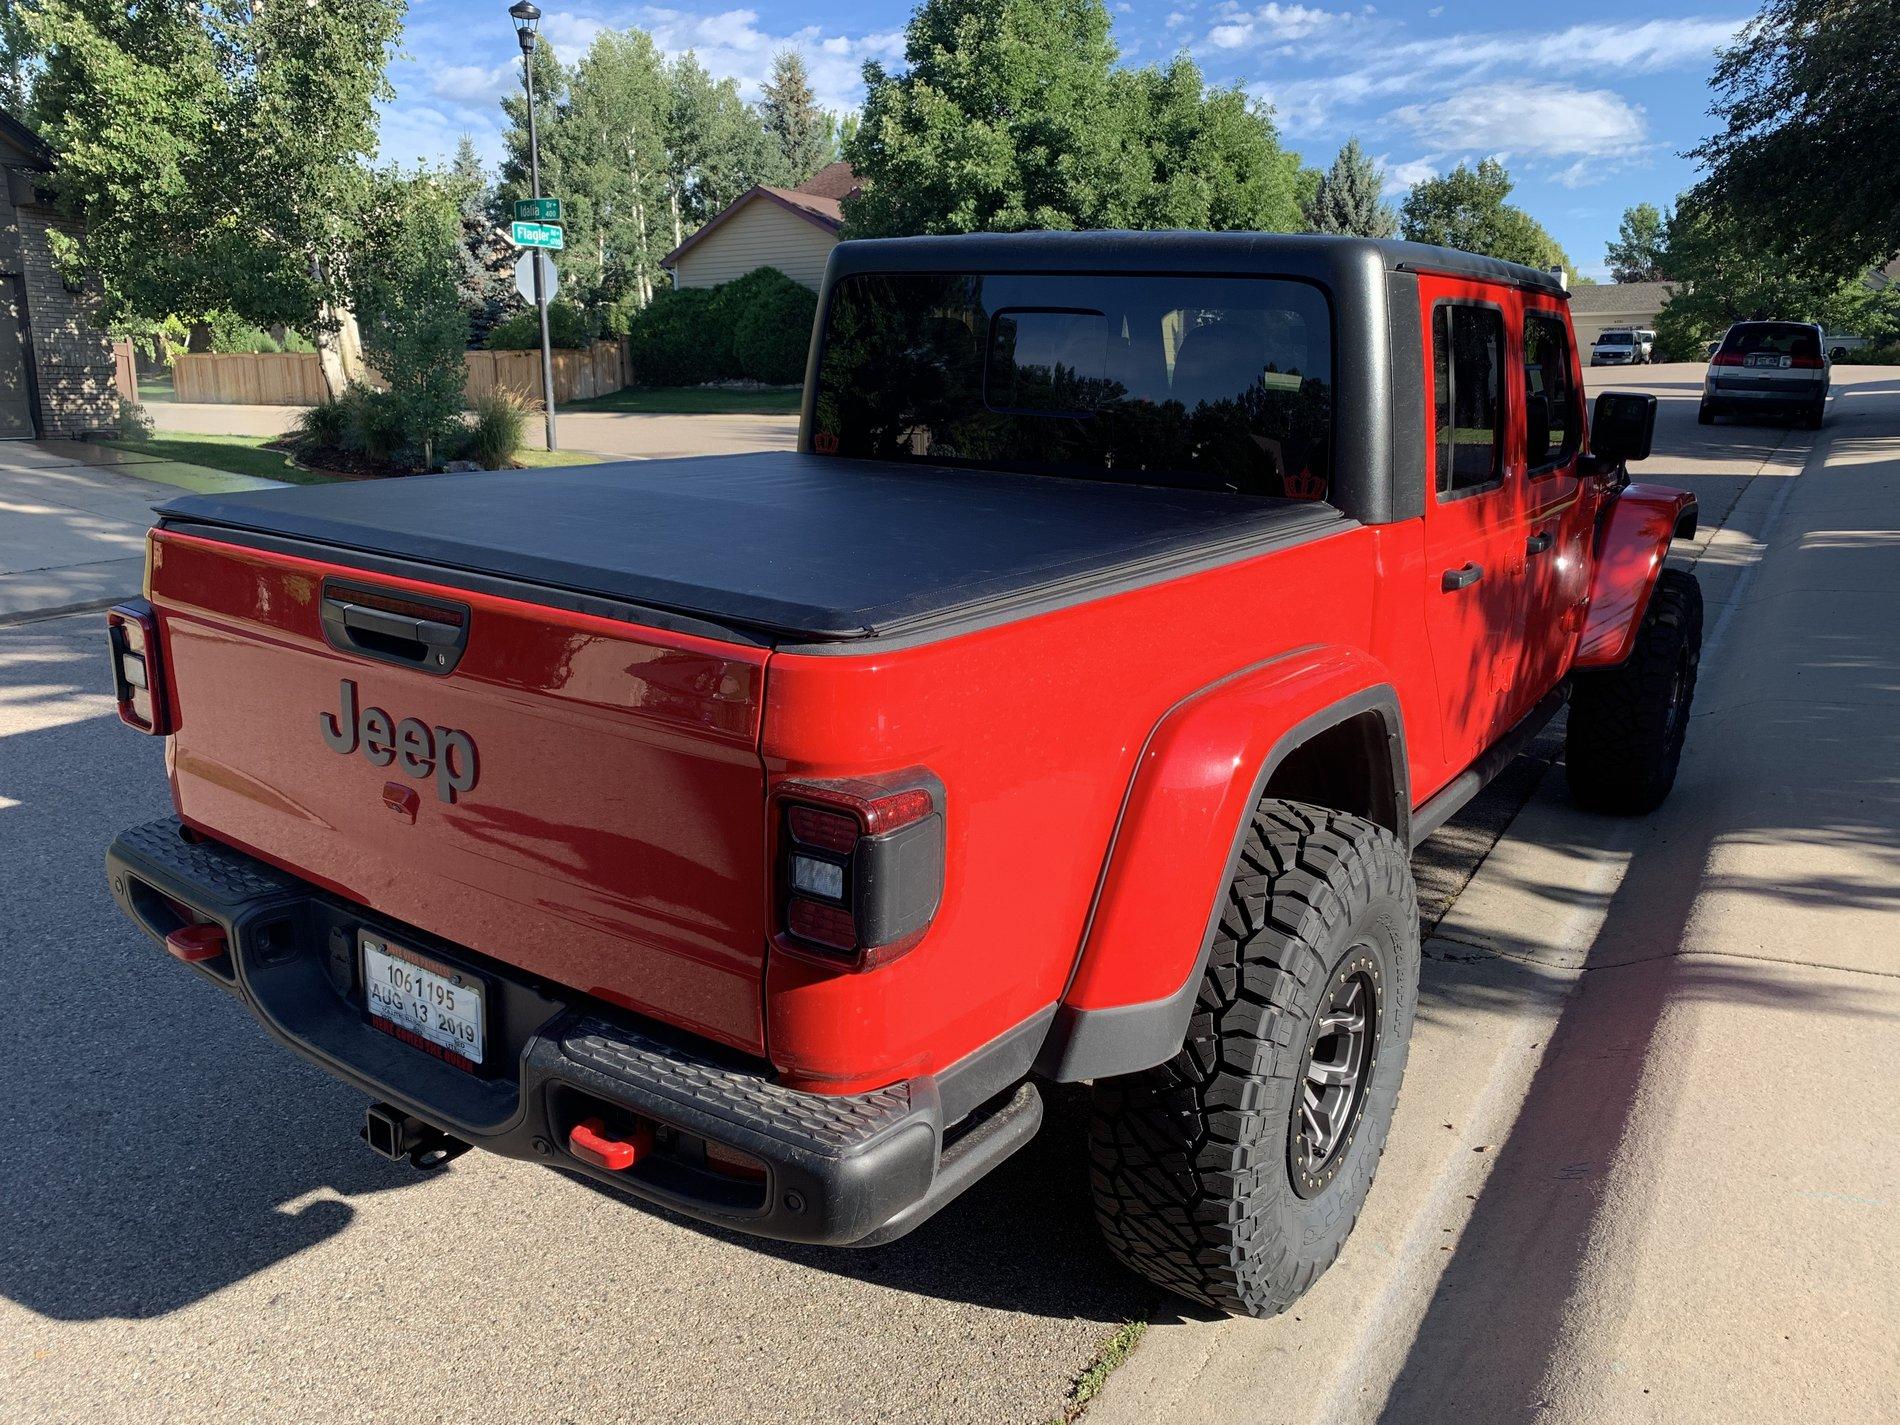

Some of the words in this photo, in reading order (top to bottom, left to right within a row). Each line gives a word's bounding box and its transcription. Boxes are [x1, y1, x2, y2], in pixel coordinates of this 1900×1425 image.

[520, 205, 540, 217] Idalia
[517, 227, 549, 244] Flagler
[320, 678, 481, 805] Jeep
[387, 964, 455, 1011] 1061195
[371, 983, 404, 1011] AUG
[412, 1001, 428, 1023] 13
[438, 1013, 475, 1043] 2019
